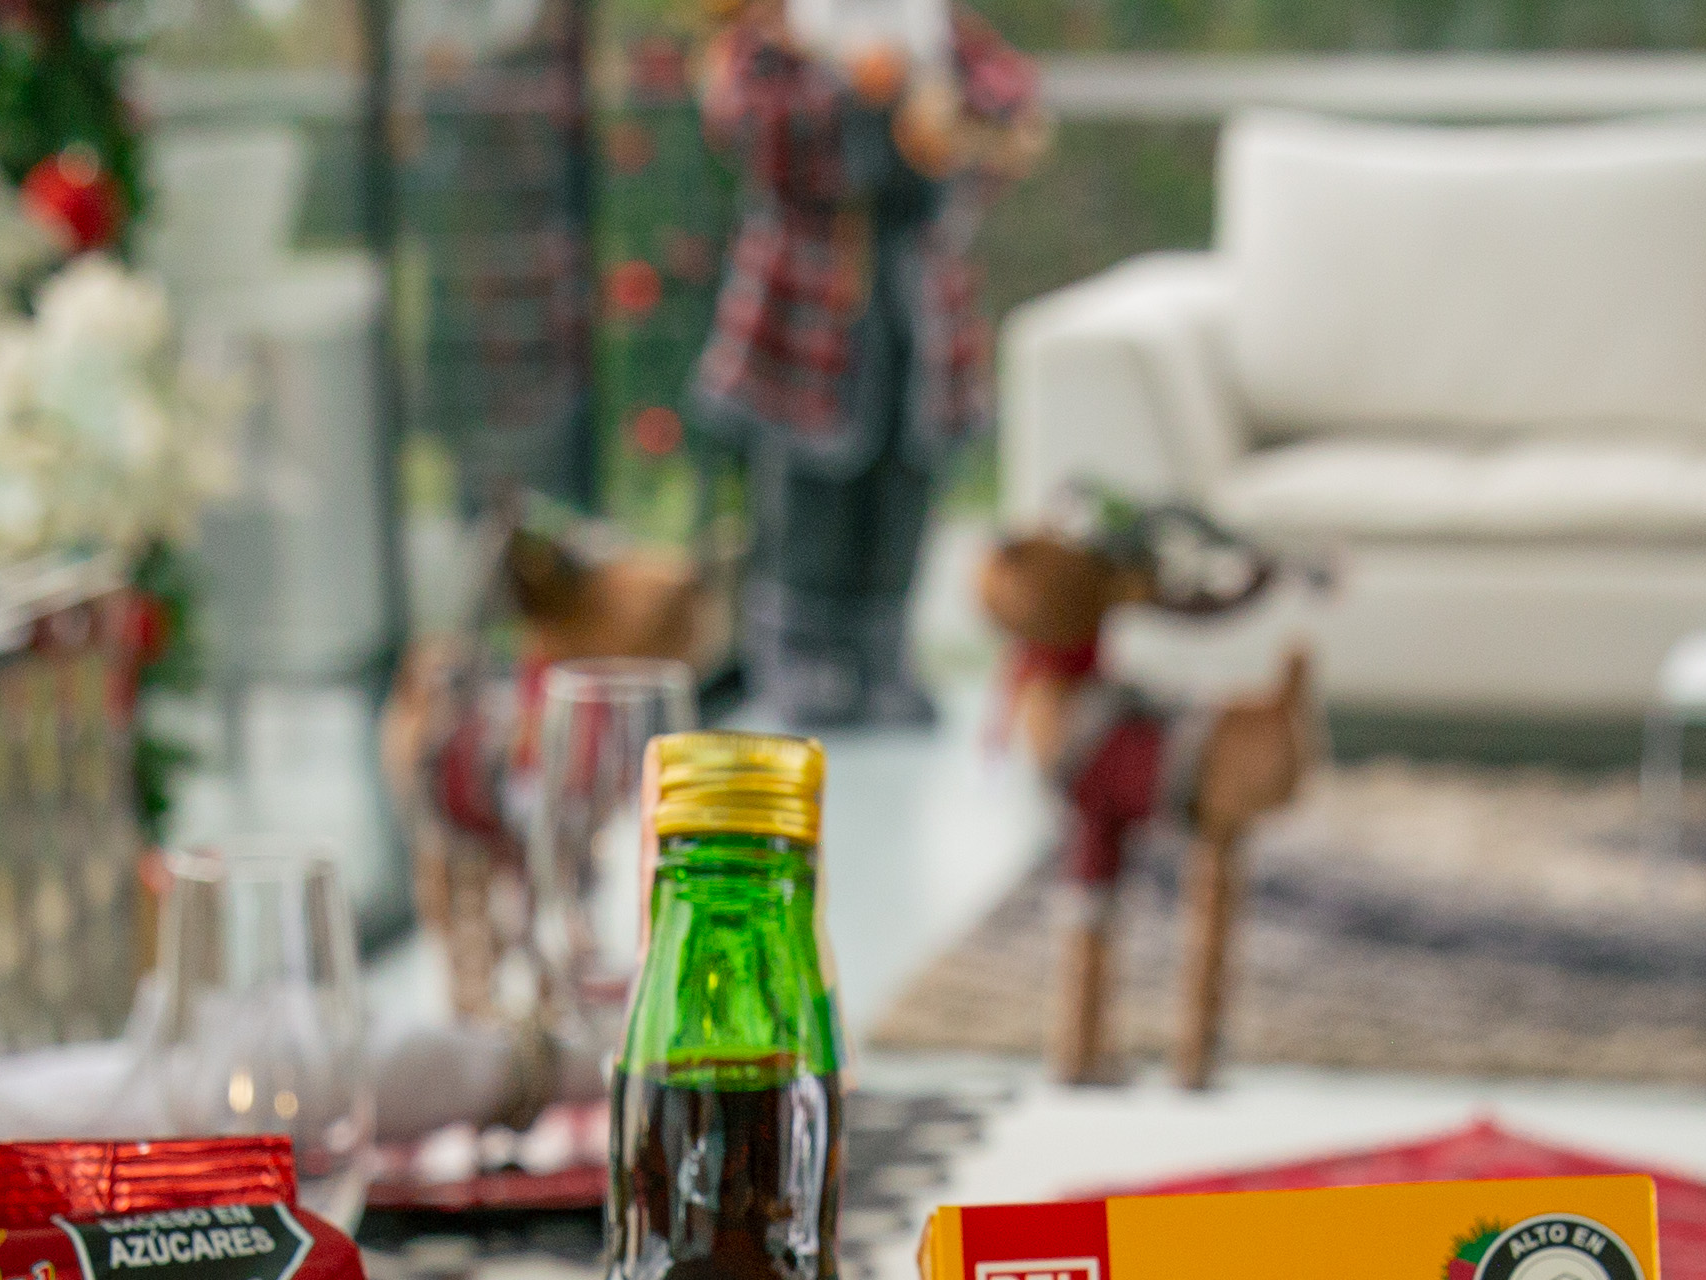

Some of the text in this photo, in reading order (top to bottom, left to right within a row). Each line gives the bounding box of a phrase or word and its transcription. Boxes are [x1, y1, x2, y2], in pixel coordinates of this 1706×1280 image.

[109, 1226, 275, 1270] AZÚCARES
[1509, 1223, 1607, 1259] ALTO EN
